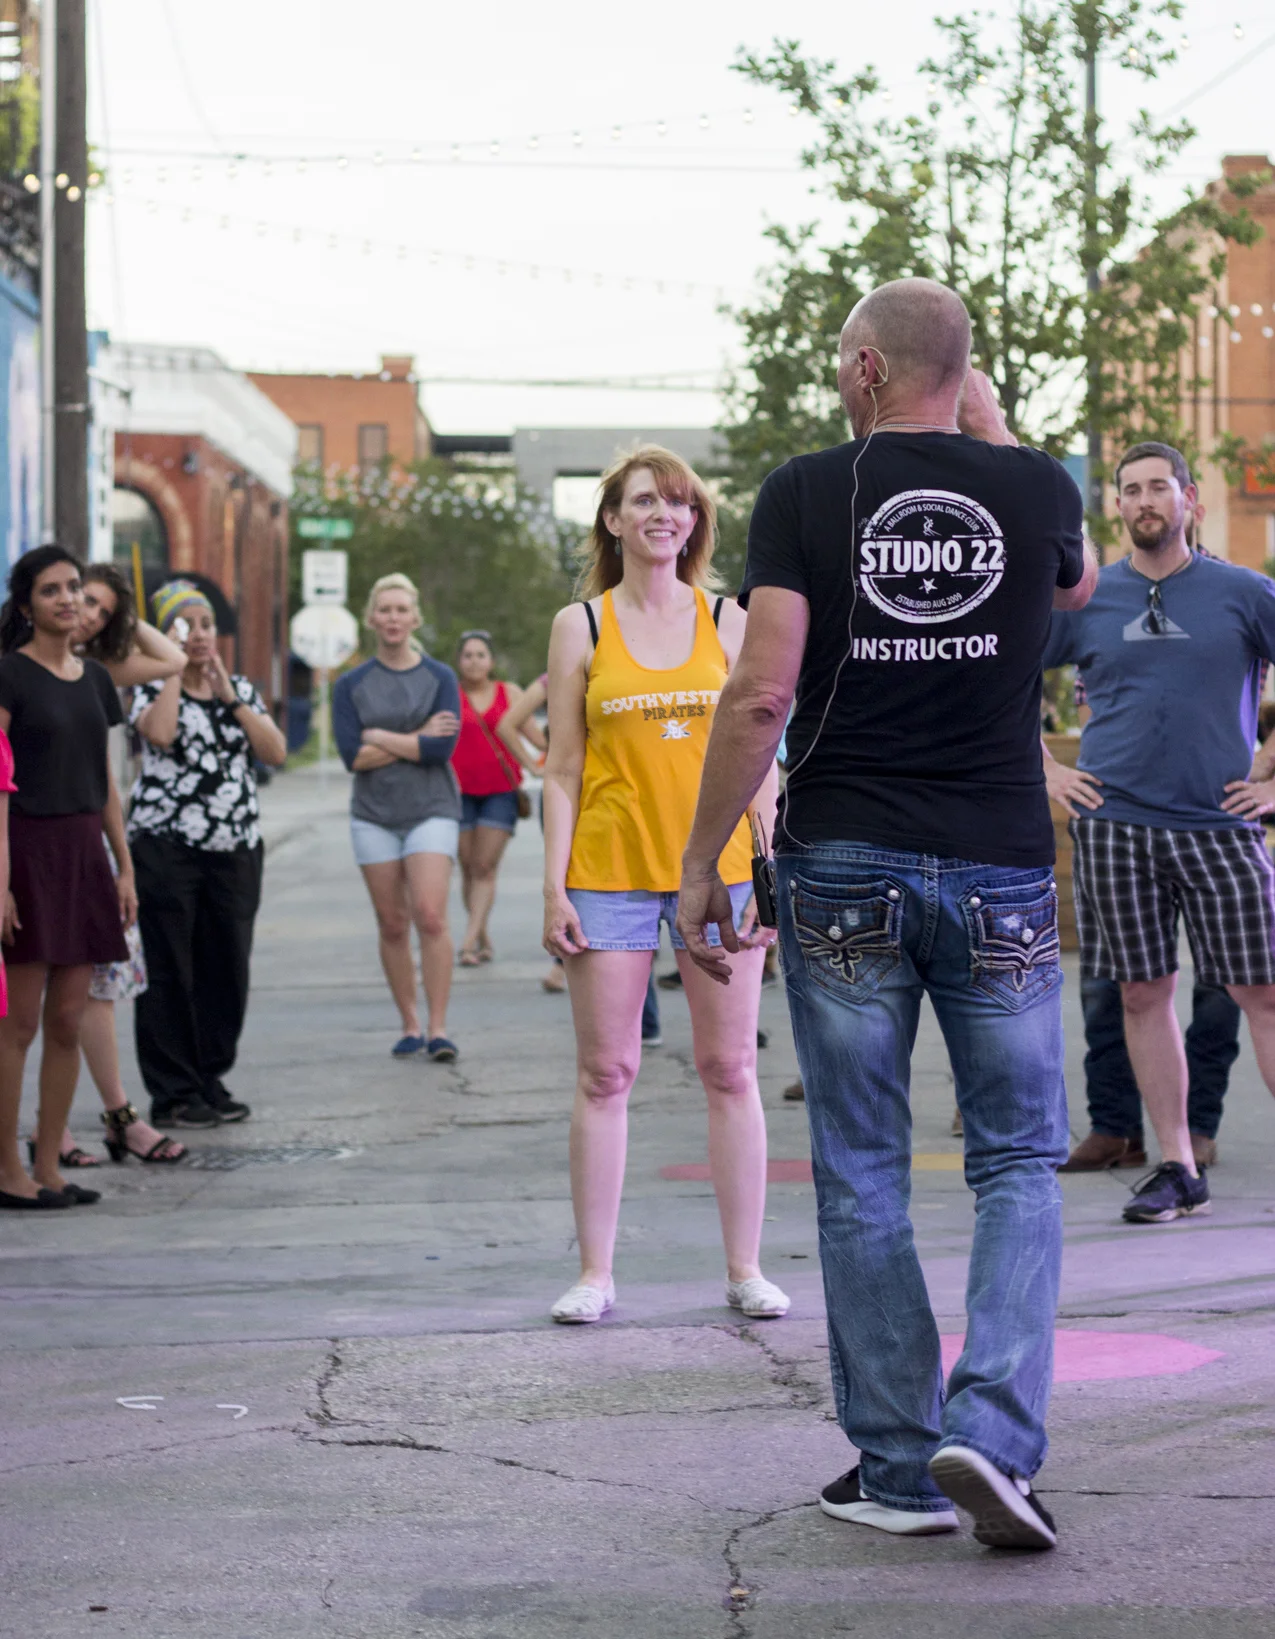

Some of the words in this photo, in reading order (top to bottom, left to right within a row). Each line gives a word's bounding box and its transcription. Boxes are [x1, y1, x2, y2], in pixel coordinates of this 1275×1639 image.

[887, 505, 917, 530] BALLROOM
[922, 503, 944, 512] SOCIAL
[945, 506, 967, 520] DANCE
[964, 516, 980, 532] CLUB
[860, 539, 962, 573] STUDIO
[971, 539, 1005, 571] 22
[894, 593, 932, 609] ESTABLISHED
[932, 598, 947, 608] AUG
[946, 592, 963, 605] 2009
[852, 634, 999, 661] INSTRUCTOR
[600, 690, 721, 715] SOUTHWESTE
[642, 704, 706, 721] PIRATES
